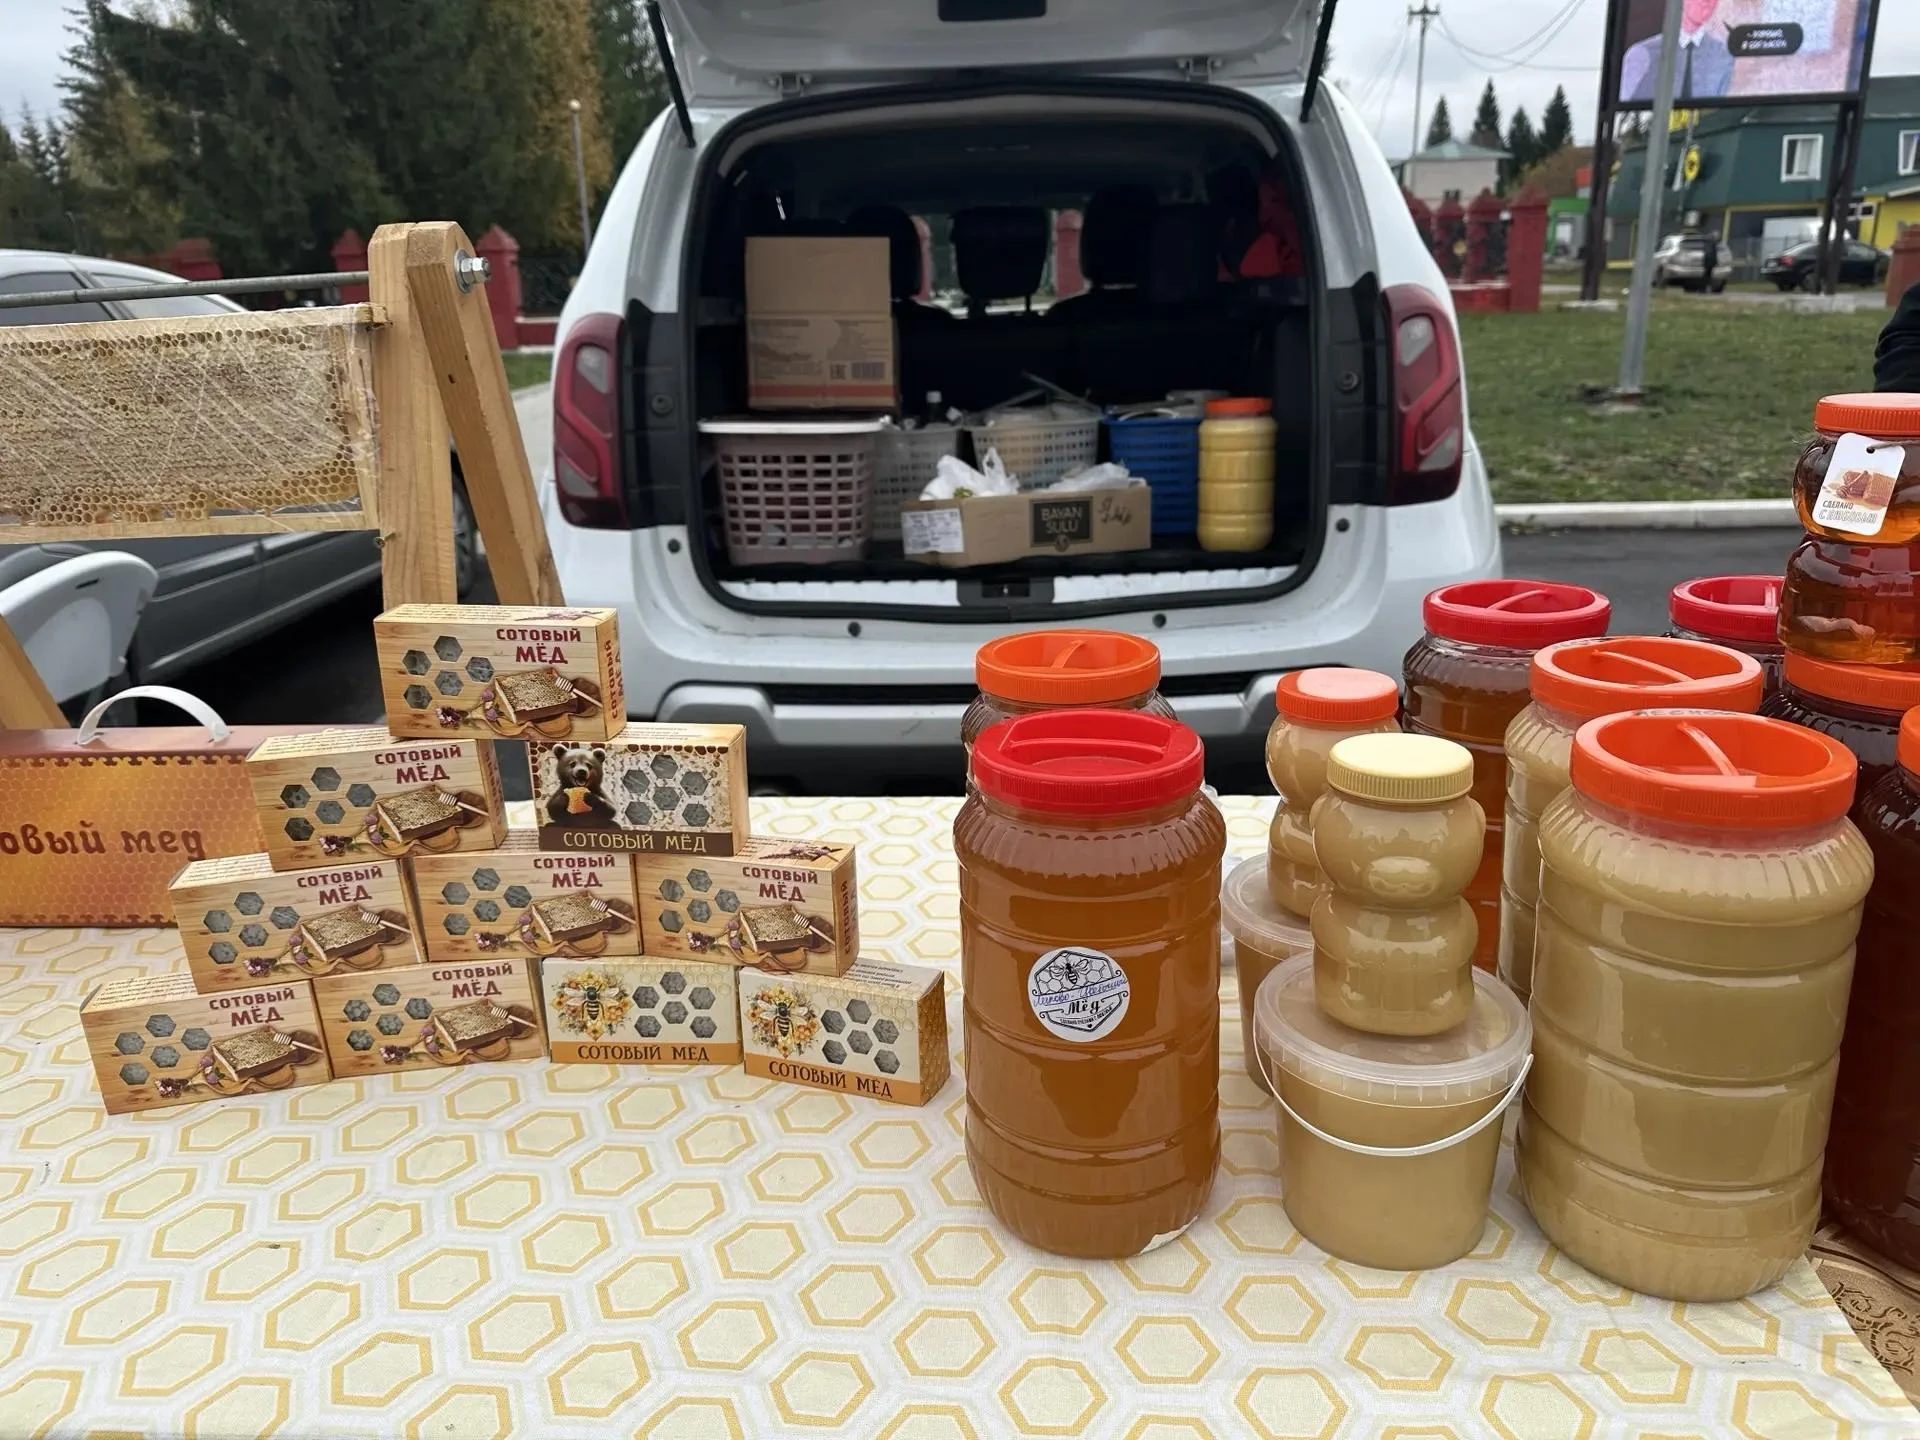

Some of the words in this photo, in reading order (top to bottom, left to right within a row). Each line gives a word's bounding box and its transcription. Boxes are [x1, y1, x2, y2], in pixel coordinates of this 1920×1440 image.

[1041, 506, 1082, 521] BAYAN
[1823, 500, 1854, 510] СДЕЛАНО
[1046, 519, 1079, 534] SULU
[496, 628, 581, 642] СОТОВЫЙ
[515, 642, 568, 664] МЁД
[605, 640, 618, 719] СОТОВЫЙ
[374, 744, 461, 765] СОТОВЫЙ
[396, 764, 450, 784] МЁД
[563, 832, 653, 849] СОТОВЫЙ
[665, 835, 706, 853] МЁД
[534, 854, 615, 869] СОТОВЫЙ
[297, 866, 383, 888] СОТОВЫЙ
[552, 869, 603, 888] МЁД
[742, 867, 818, 884] СОТОВЫЙ
[319, 885, 373, 906] МЁД
[759, 882, 806, 903] МЁД
[432, 963, 513, 981] СОТОВЫЙ
[209, 988, 295, 1010] СОТОВЫЙ
[452, 980, 502, 999] МЁД
[231, 1006, 284, 1027] МЁД
[1067, 1000, 1100, 1015] Мёд
[578, 1044, 661, 1060] СОТОВЫЙ
[769, 1061, 846, 1088] СОТОВЫЙ
